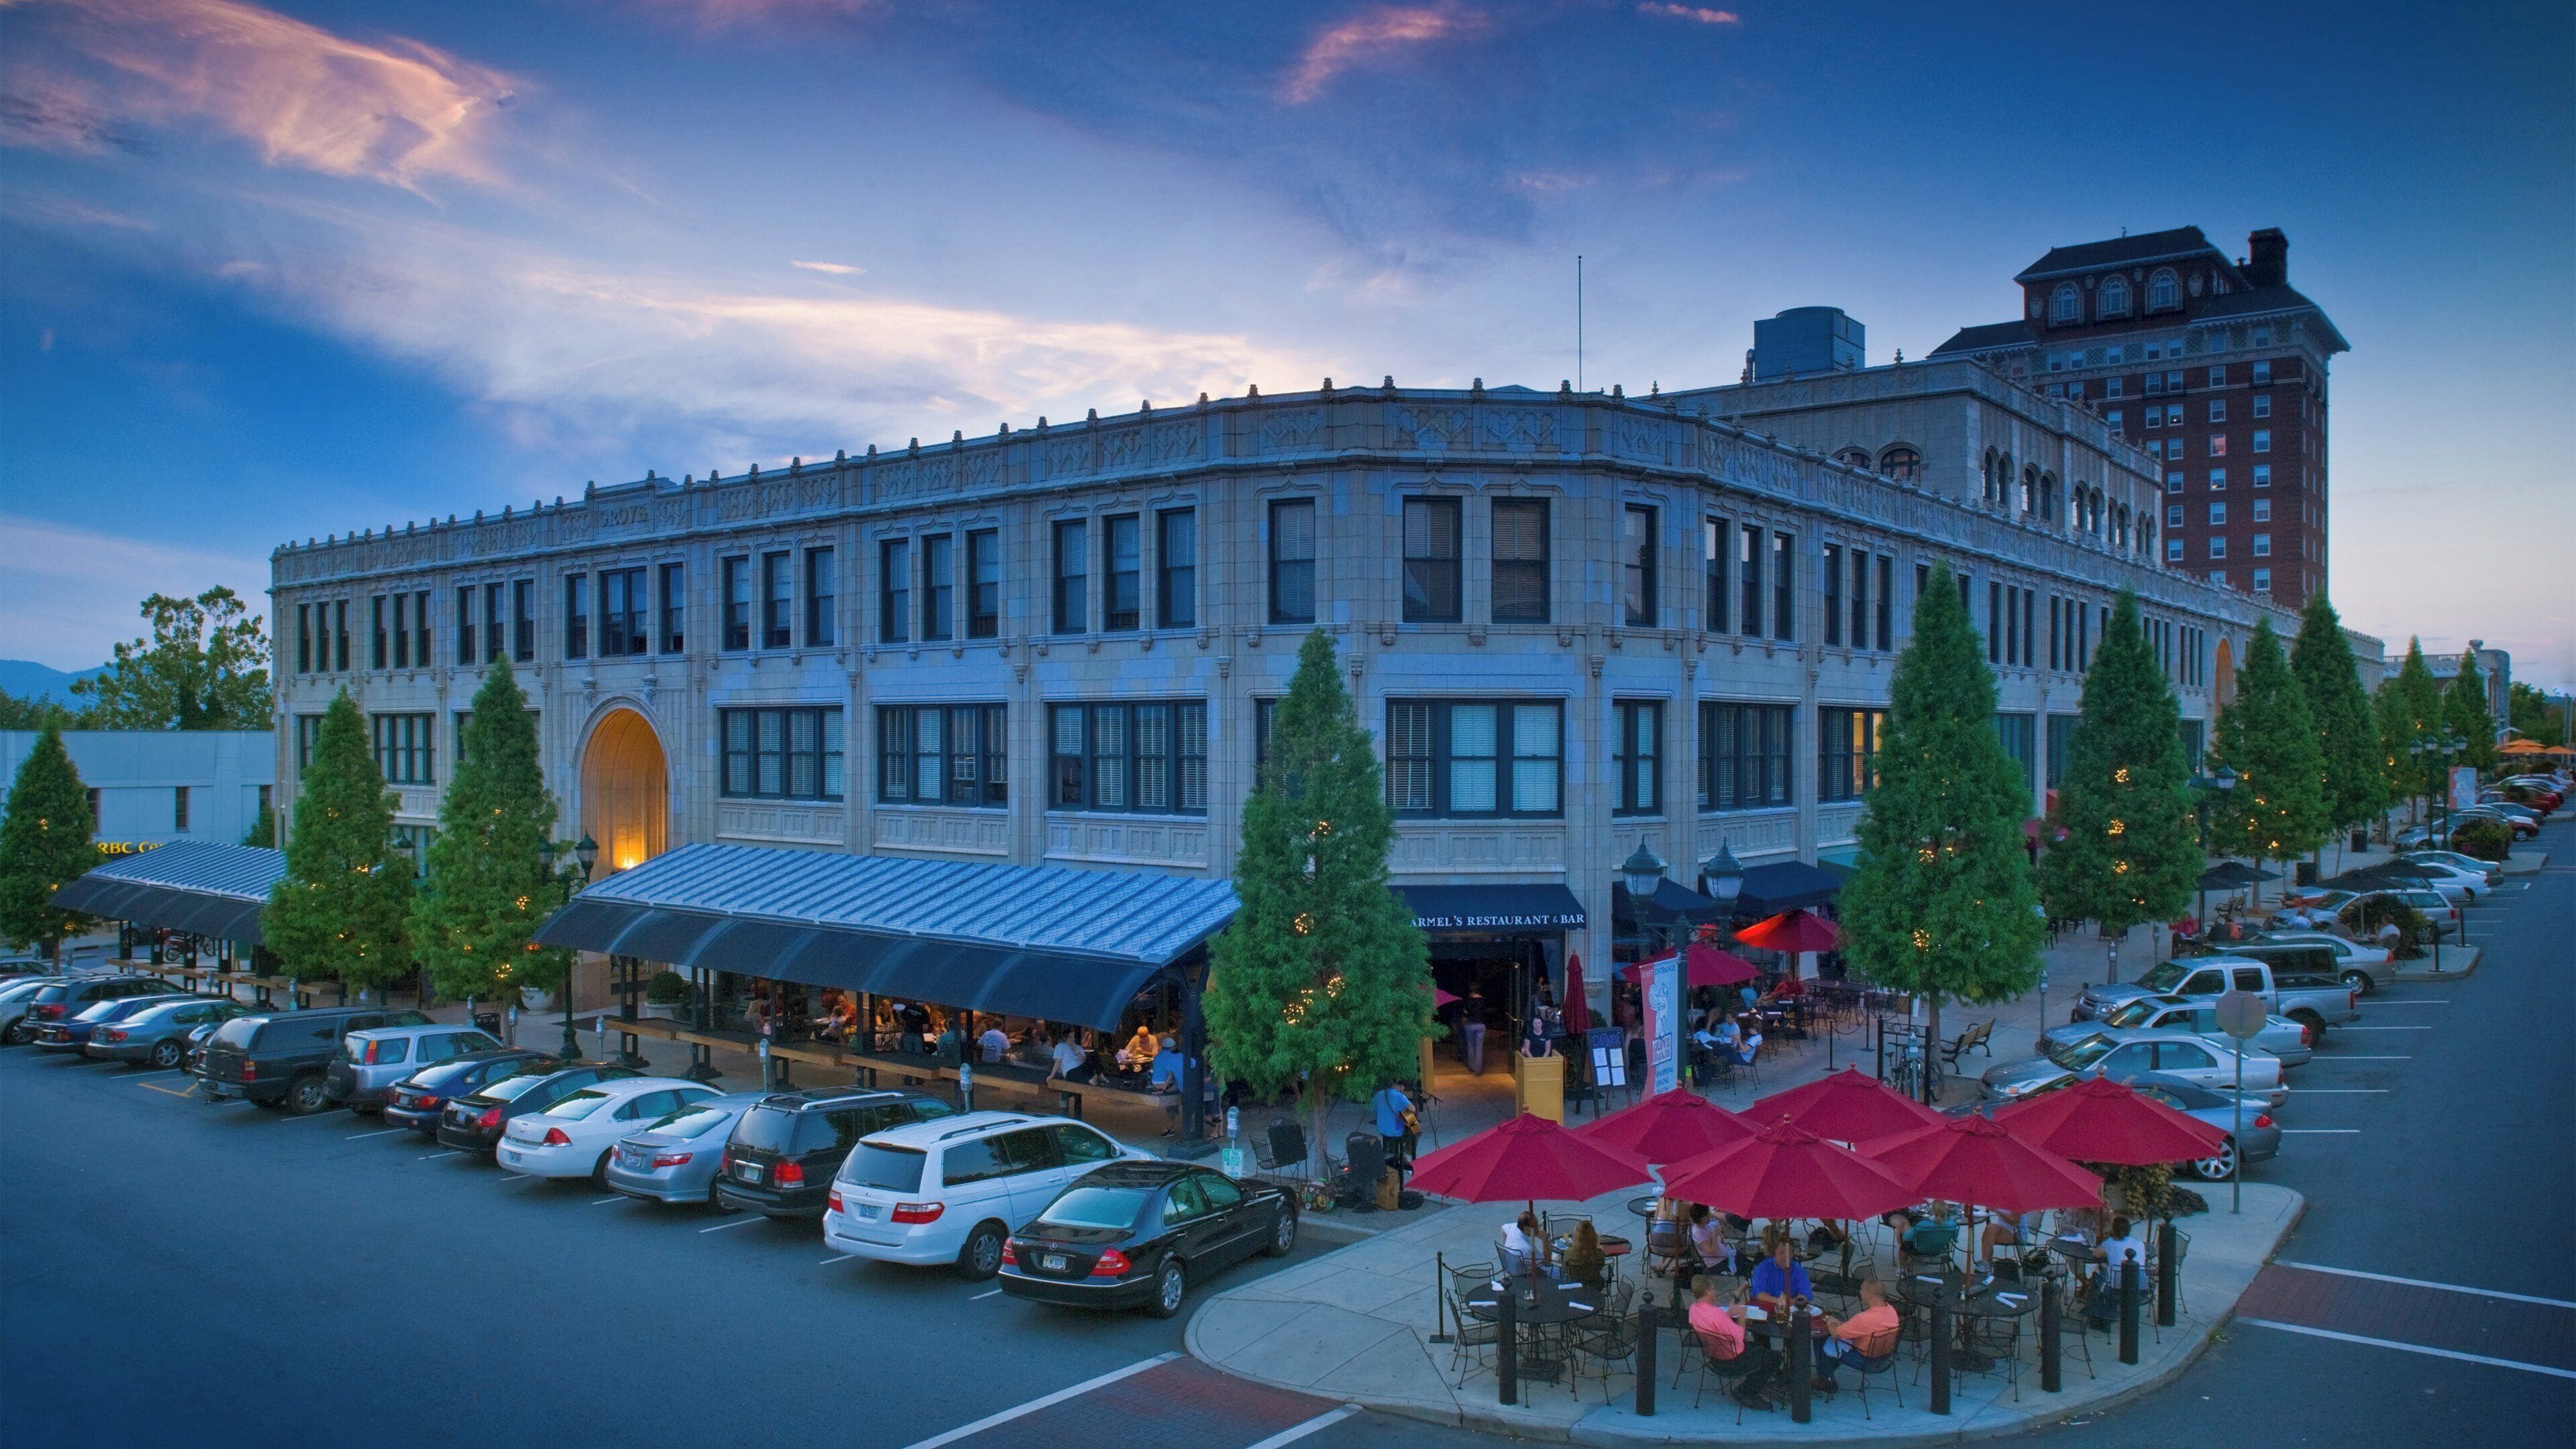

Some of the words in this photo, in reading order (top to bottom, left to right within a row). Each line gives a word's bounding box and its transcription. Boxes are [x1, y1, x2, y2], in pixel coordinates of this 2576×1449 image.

[97, 841, 133, 854] RBC
[1466, 915, 1550, 926] RESTAURANT
[1560, 914, 1585, 924] BAR
[1642, 969, 1654, 978] EAST
[1654, 964, 1676, 975] ENTRANCE
